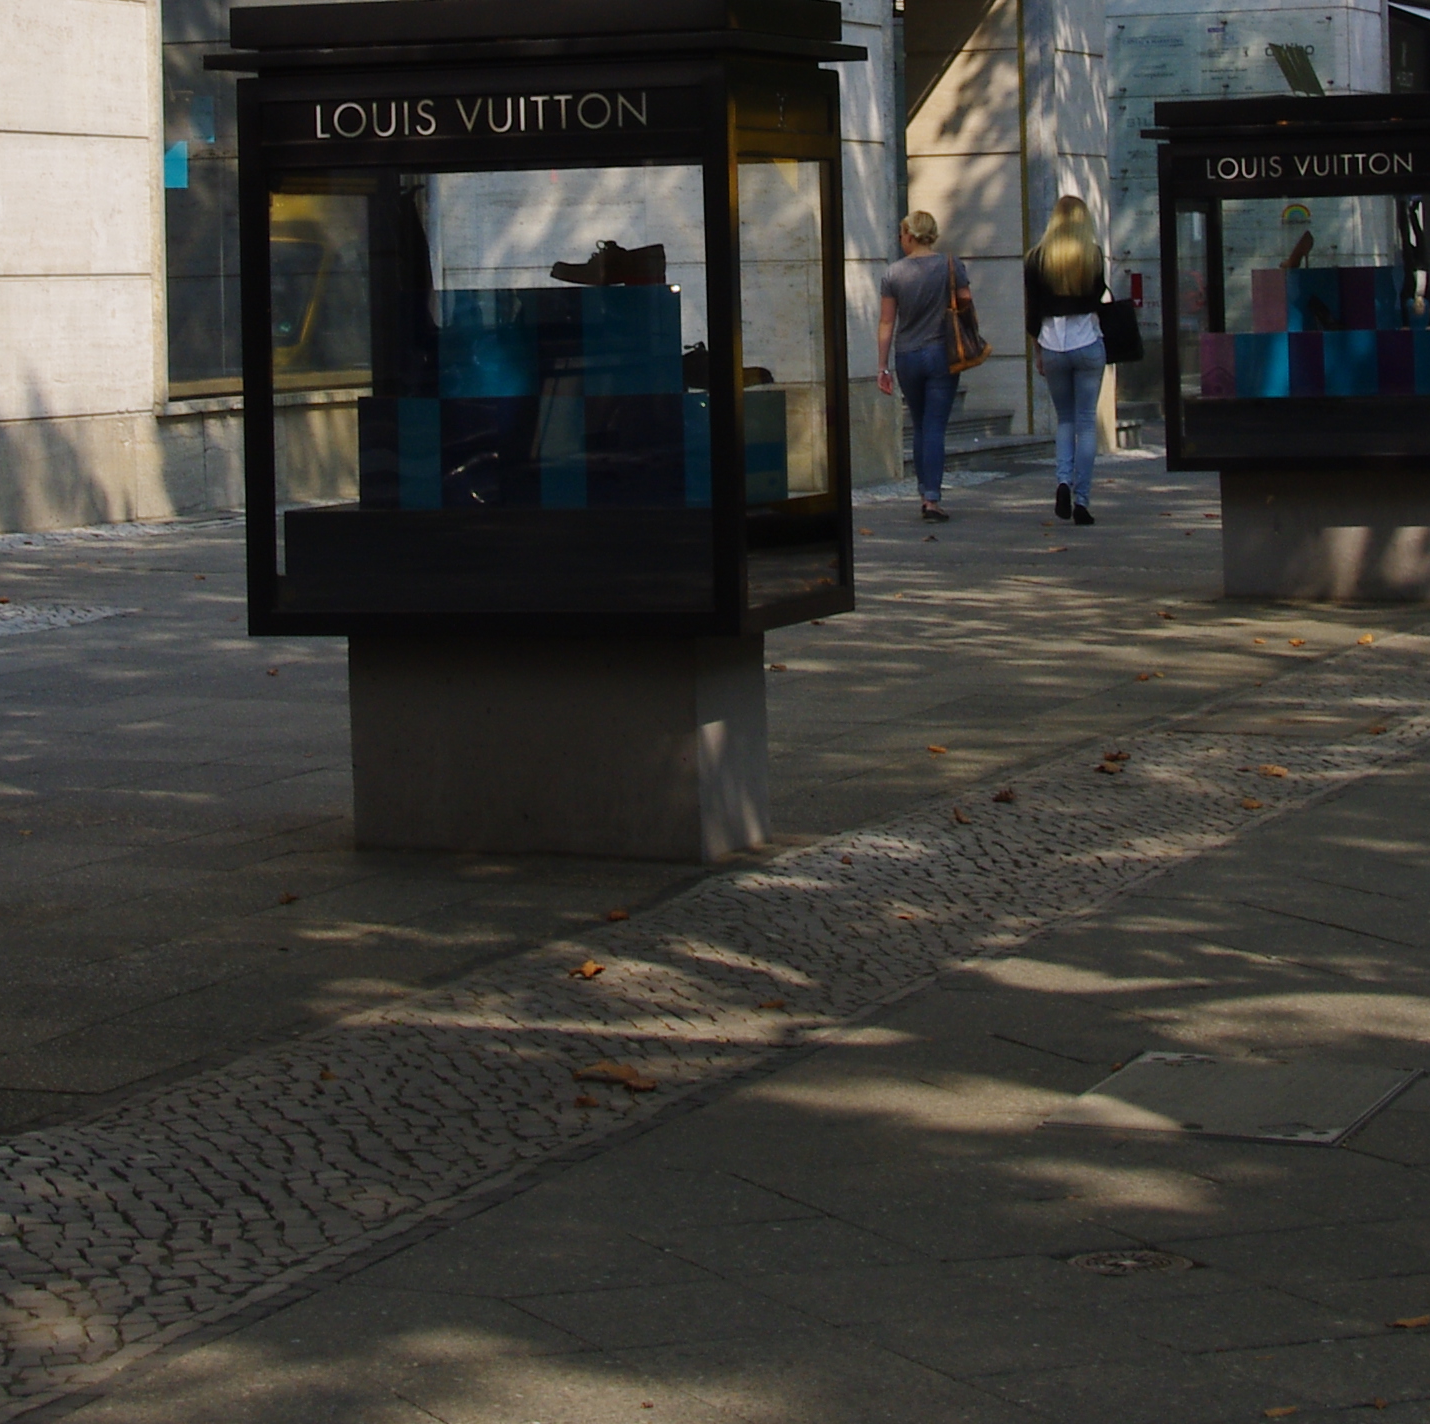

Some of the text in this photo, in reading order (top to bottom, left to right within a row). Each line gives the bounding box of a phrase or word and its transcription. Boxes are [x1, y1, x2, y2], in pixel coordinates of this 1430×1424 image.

[315, 92, 648, 139] LOUIS VUITTON
[1206, 152, 1414, 180] LOUIS VUITTON
